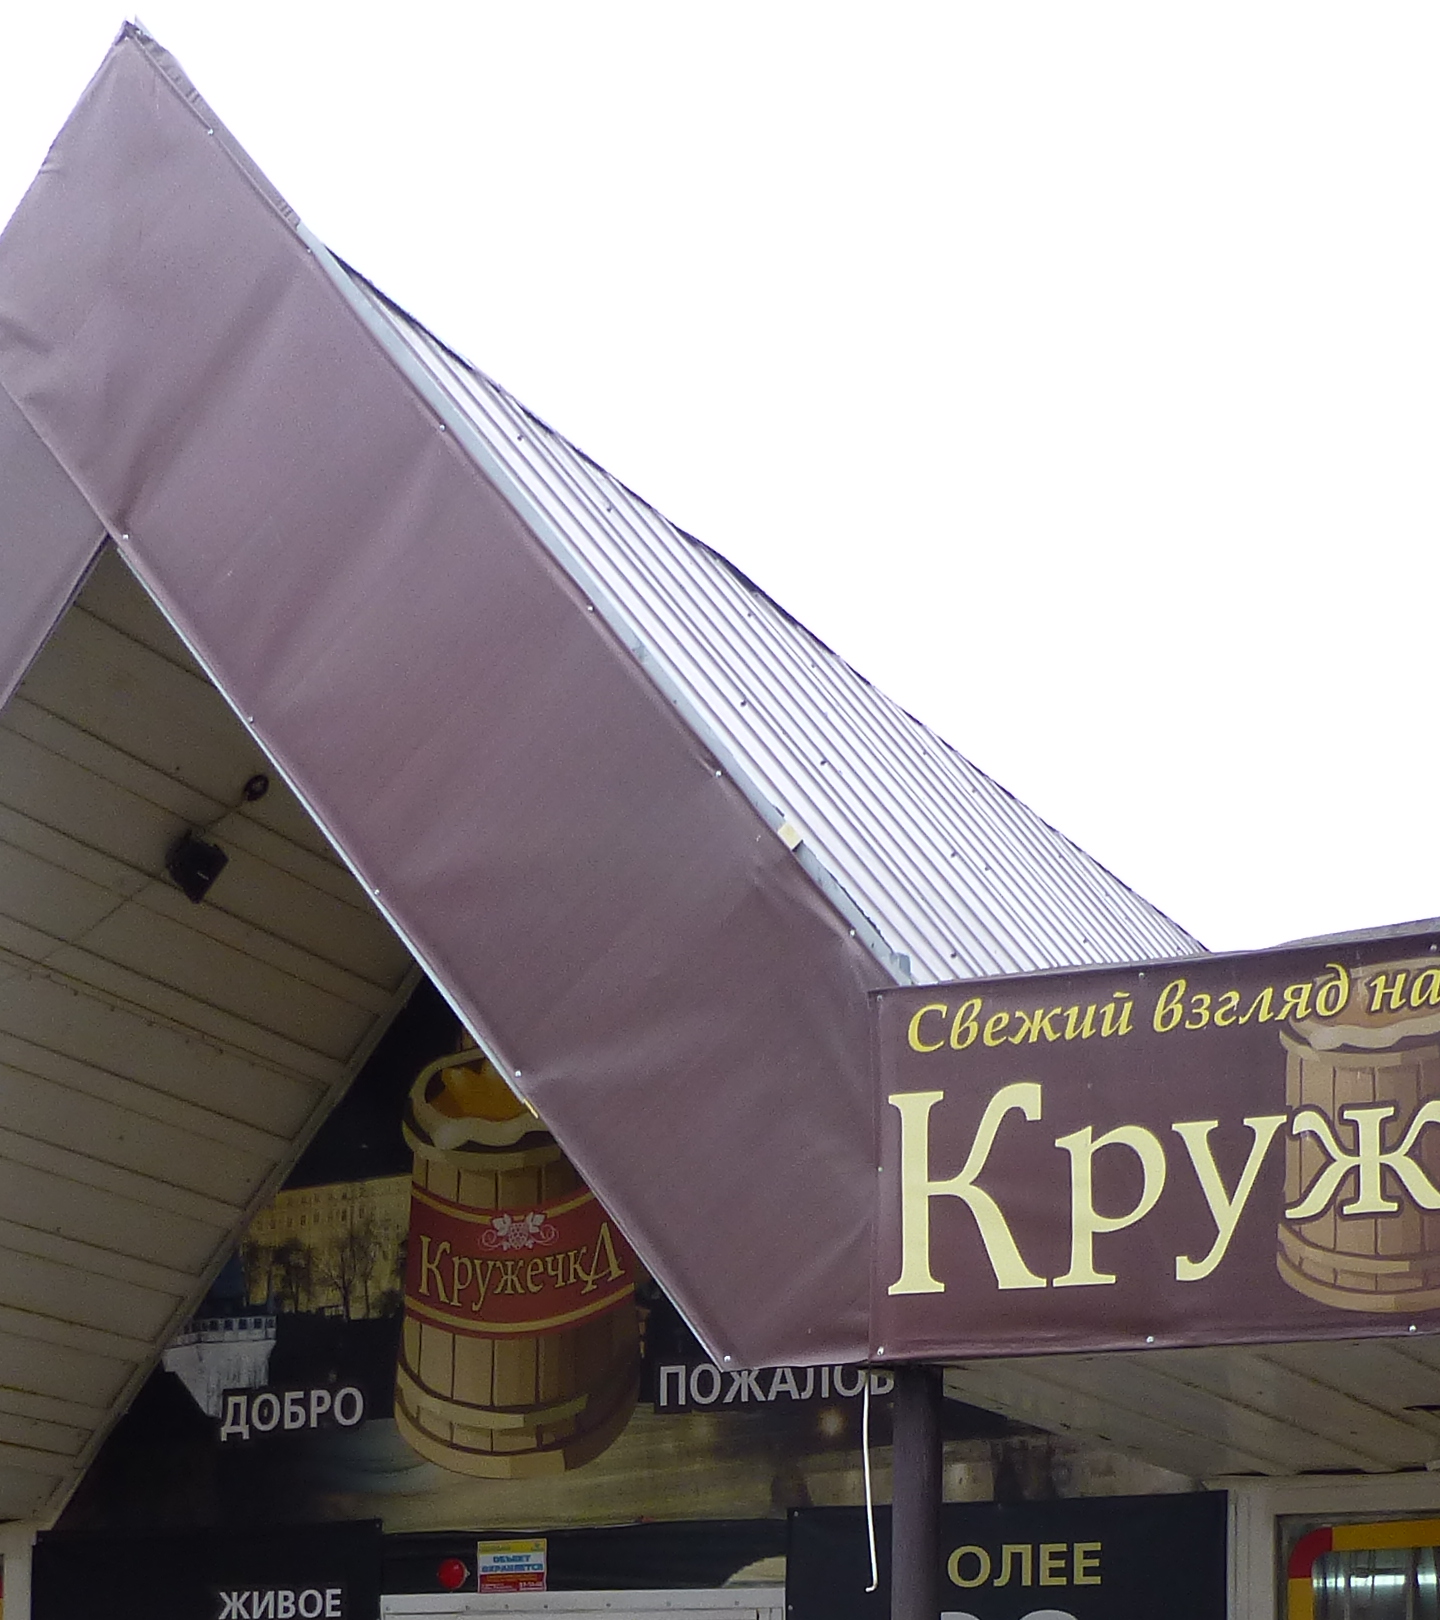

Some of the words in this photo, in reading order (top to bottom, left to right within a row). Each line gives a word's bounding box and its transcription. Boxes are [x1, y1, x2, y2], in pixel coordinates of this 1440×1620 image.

[907, 988, 1136, 1053] Свежий
[1151, 962, 1348, 1033] взгляд
[658, 1363, 896, 1407] ПОЖАЛОВ
[220, 1386, 364, 1442] ДОБРО
[946, 1541, 1103, 1588] ОЛЕЕ
[218, 1588, 343, 1620] ЖИВОЕ
